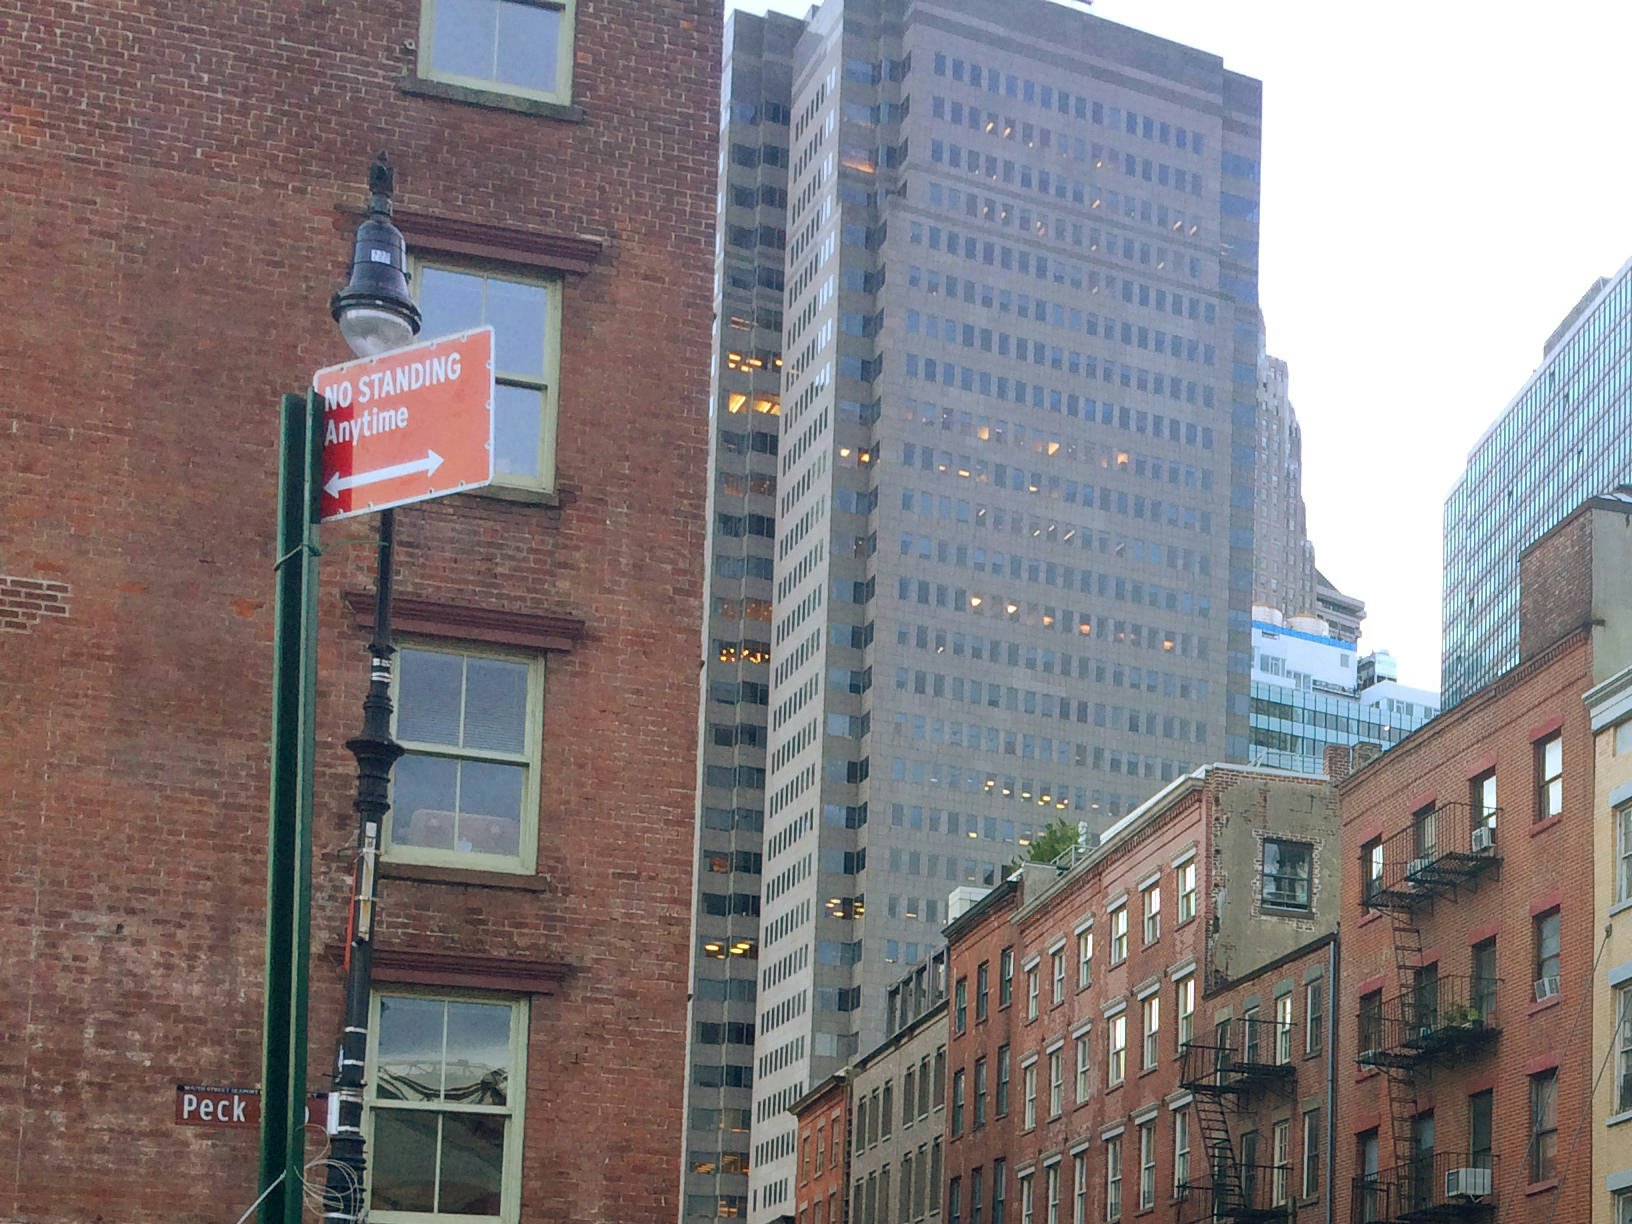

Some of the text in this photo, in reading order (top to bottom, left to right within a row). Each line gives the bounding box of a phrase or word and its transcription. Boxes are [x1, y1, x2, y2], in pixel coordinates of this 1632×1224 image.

[325, 352, 461, 412] NO STANDING
[325, 406, 409, 447] Anytime
[183, 1094, 246, 1122] Peck
